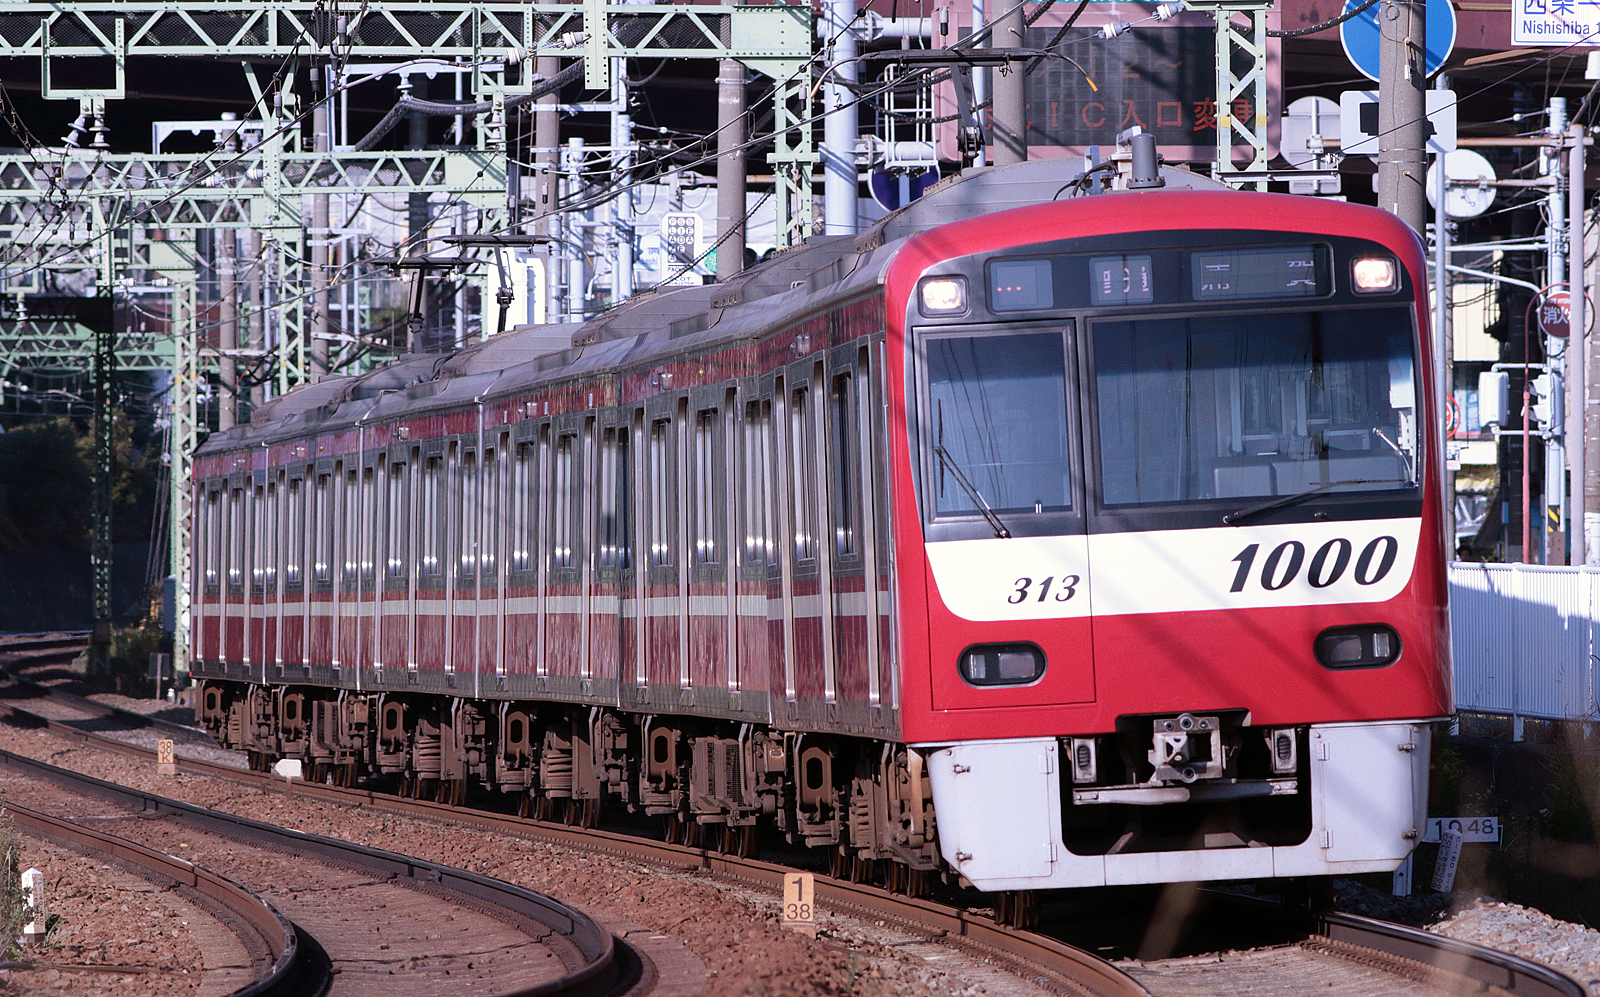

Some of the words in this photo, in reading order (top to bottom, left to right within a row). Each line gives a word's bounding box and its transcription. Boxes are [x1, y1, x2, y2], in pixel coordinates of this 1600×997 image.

[1523, 20, 1590, 35] Nishishiba
[1543, 306, 1571, 324] 消火
[1229, 535, 1398, 593] 1000
[1008, 574, 1081, 604] 313
[160, 741, 172, 754] 38
[162, 754, 170, 762] K
[792, 877, 803, 901] 1
[786, 903, 811, 920] 38
